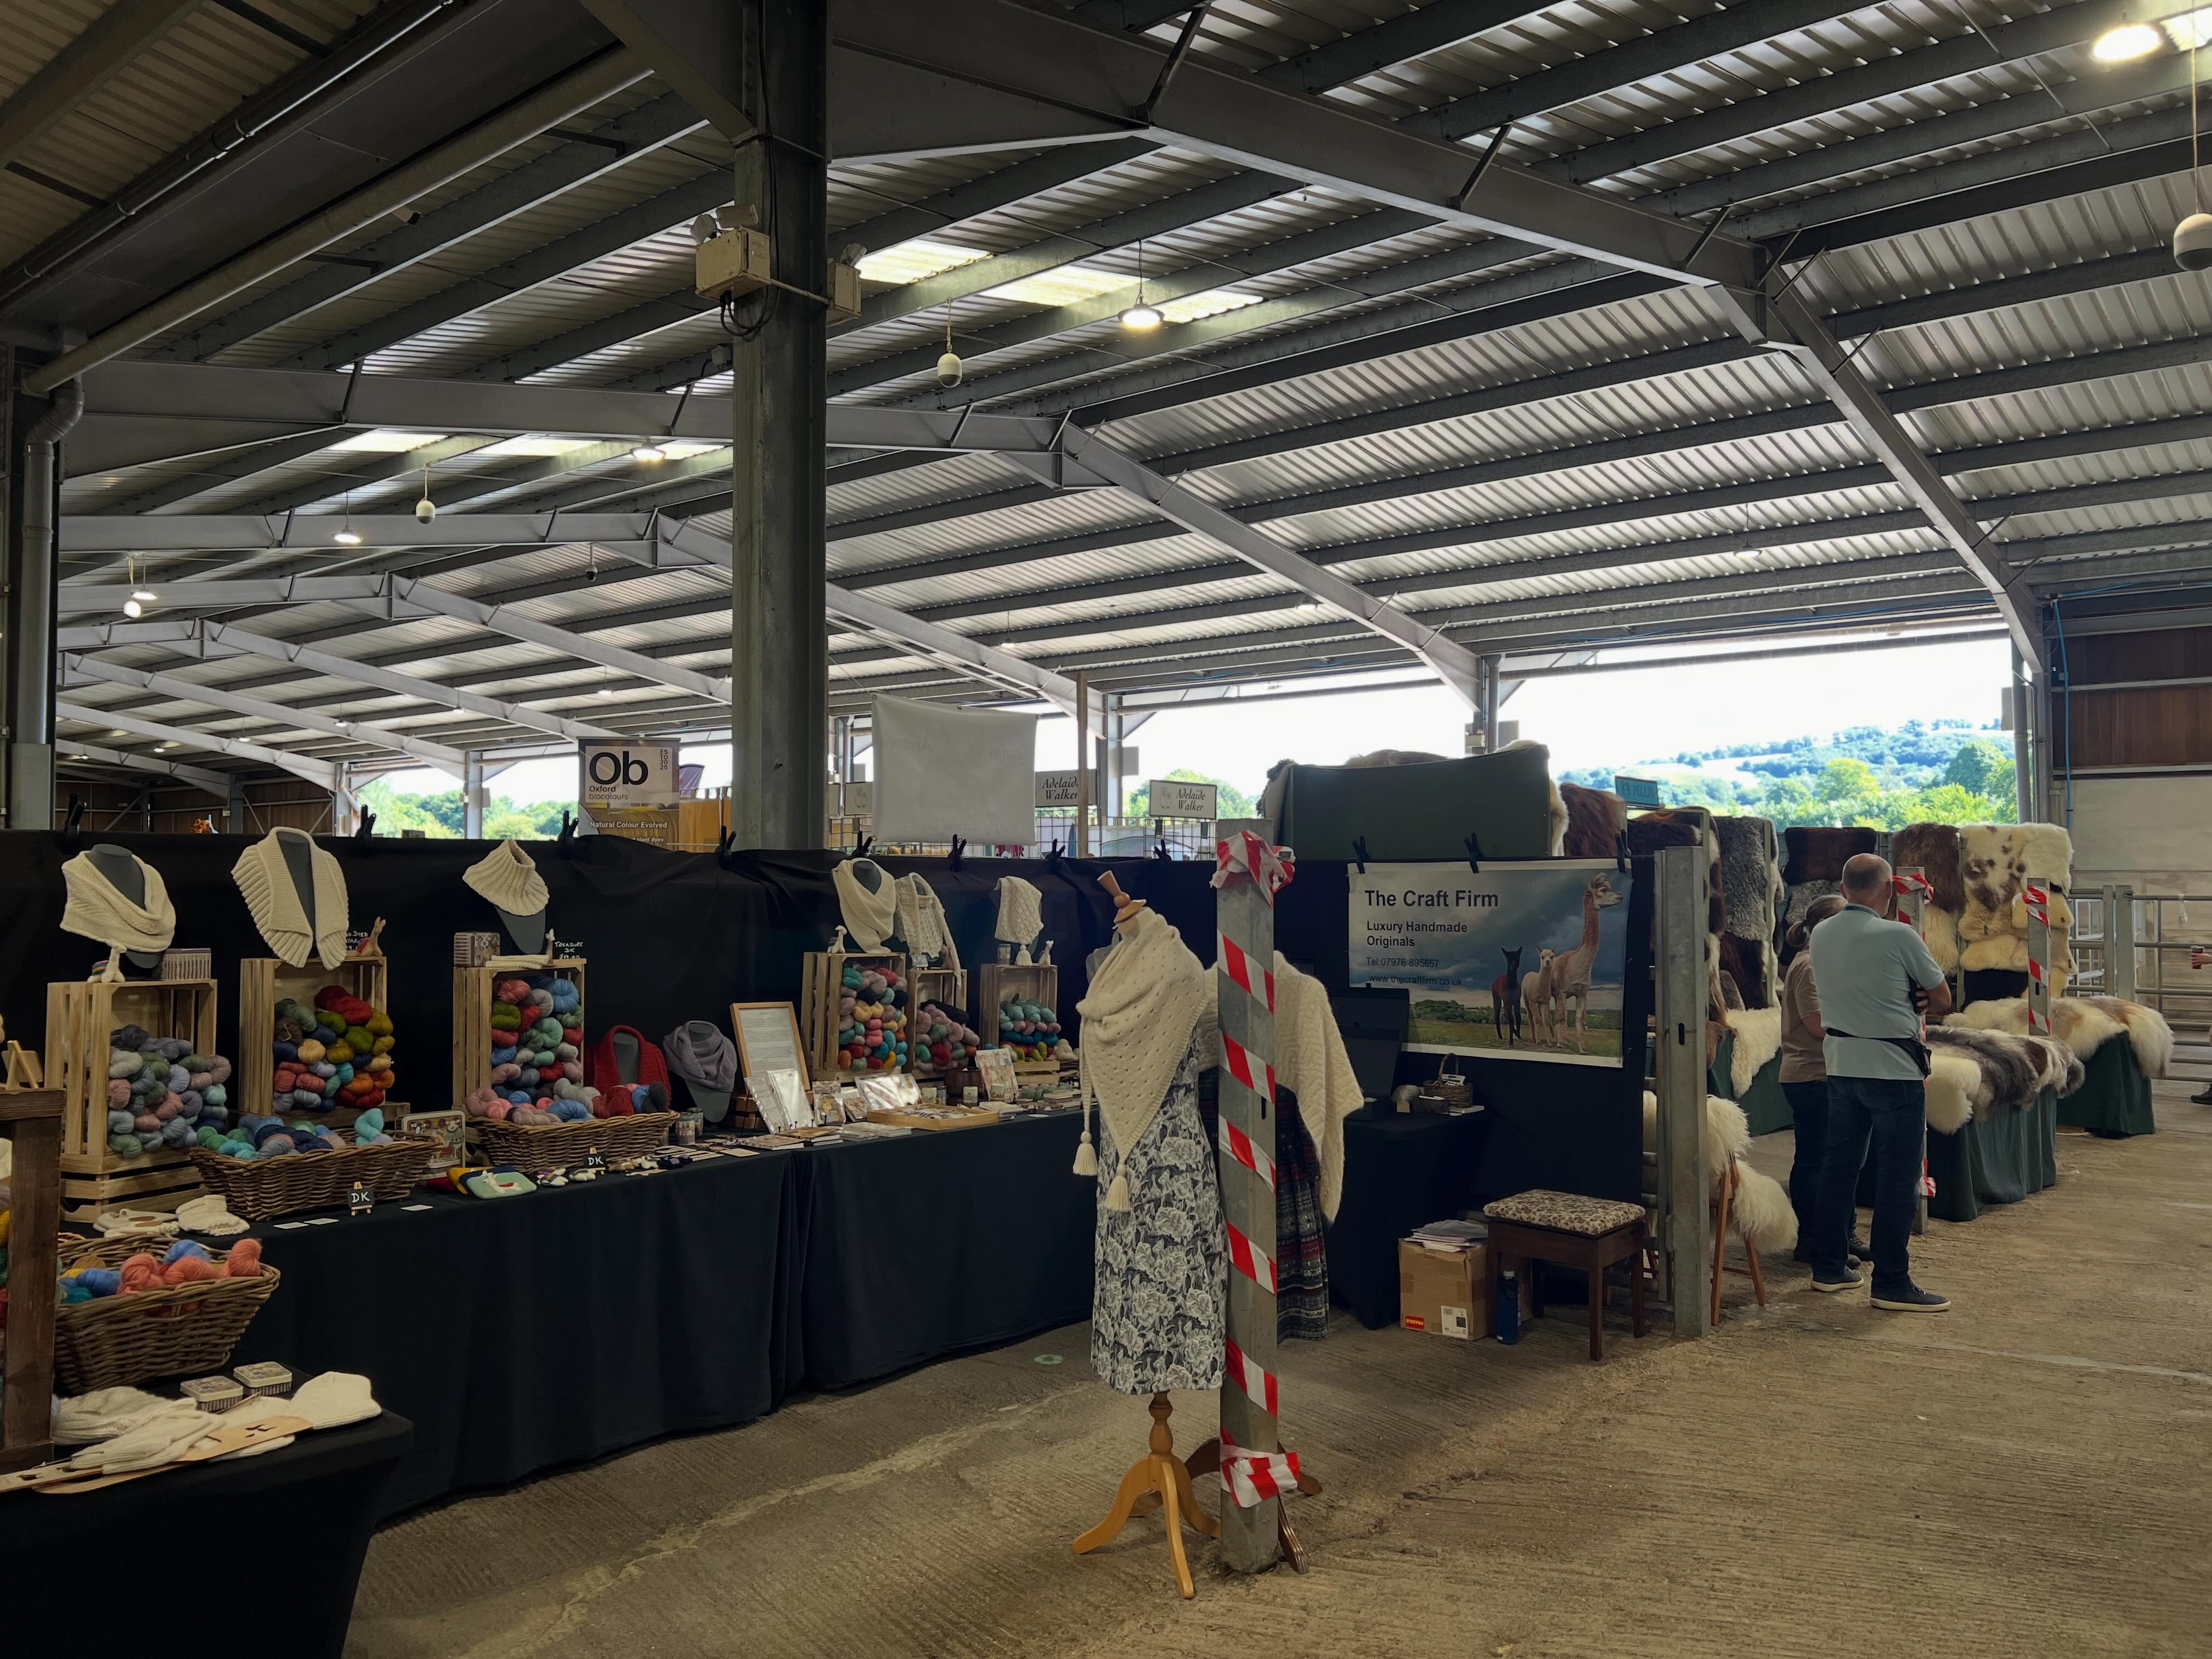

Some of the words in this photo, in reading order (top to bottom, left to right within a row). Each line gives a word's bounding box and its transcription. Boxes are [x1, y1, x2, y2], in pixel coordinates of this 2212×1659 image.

[589, 751, 648, 785] Ob
[1176, 788, 1206, 800] Adelaide
[1178, 800, 1204, 811] Walker
[1365, 890, 1396, 906] The
[1403, 890, 1449, 907] Craft
[1455, 890, 1498, 907] Firm
[1367, 921, 1403, 933] Luxury
[1406, 922, 1468, 932] Handmade
[1367, 935, 1415, 948] Originals
[1409, 958, 1440, 968] 895657
[1368, 974, 1463, 986] www.thecraftfirm.co.uk
[588, 1155, 604, 1166] DK
[351, 1191, 370, 1203] DK
